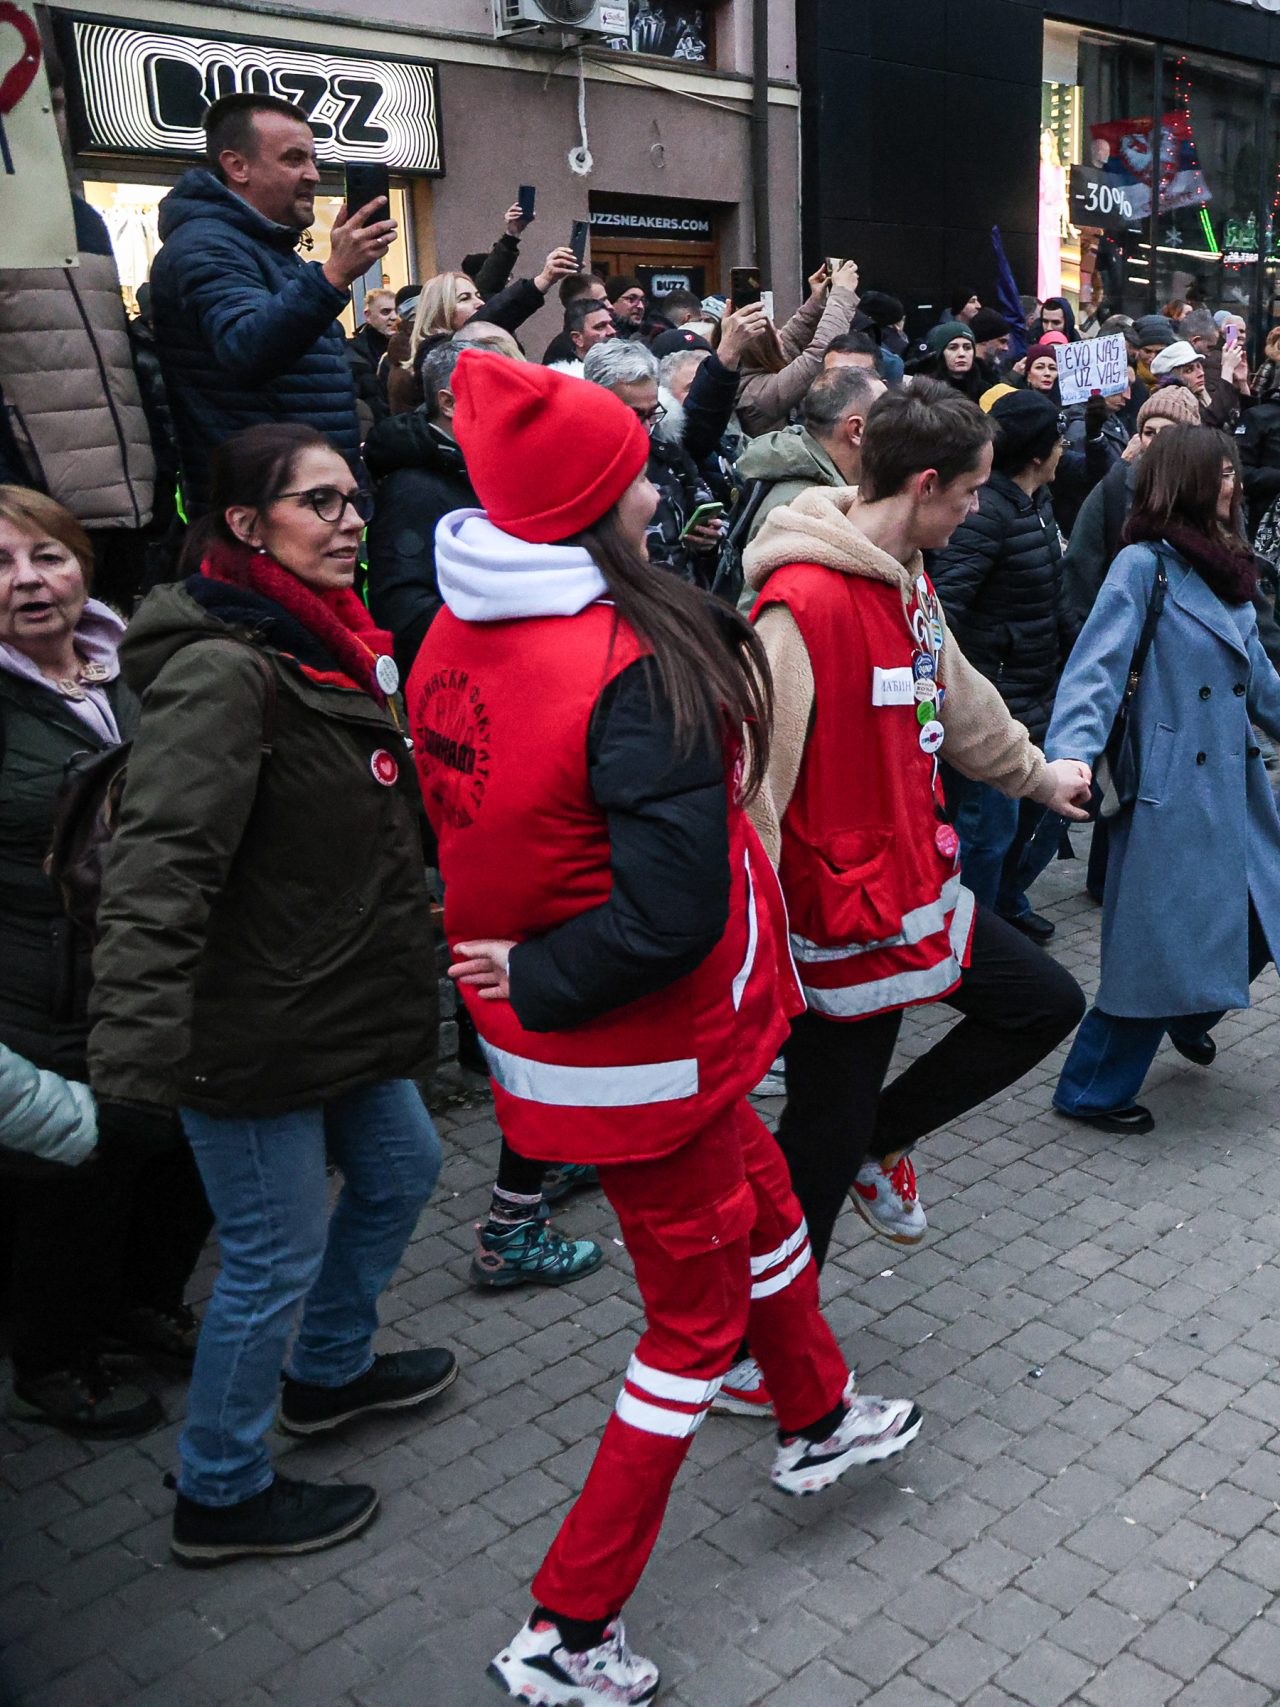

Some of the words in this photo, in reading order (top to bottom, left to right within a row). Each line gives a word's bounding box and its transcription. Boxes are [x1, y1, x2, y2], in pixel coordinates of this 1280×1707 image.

[1075, 182, 1132, 218] -30%
[589, 212, 709, 232] UZZSNEAKERS.COM
[1065, 344, 1091, 369] EVO
[1074, 366, 1092, 387] UZ
[1097, 361, 1121, 385] VAS
